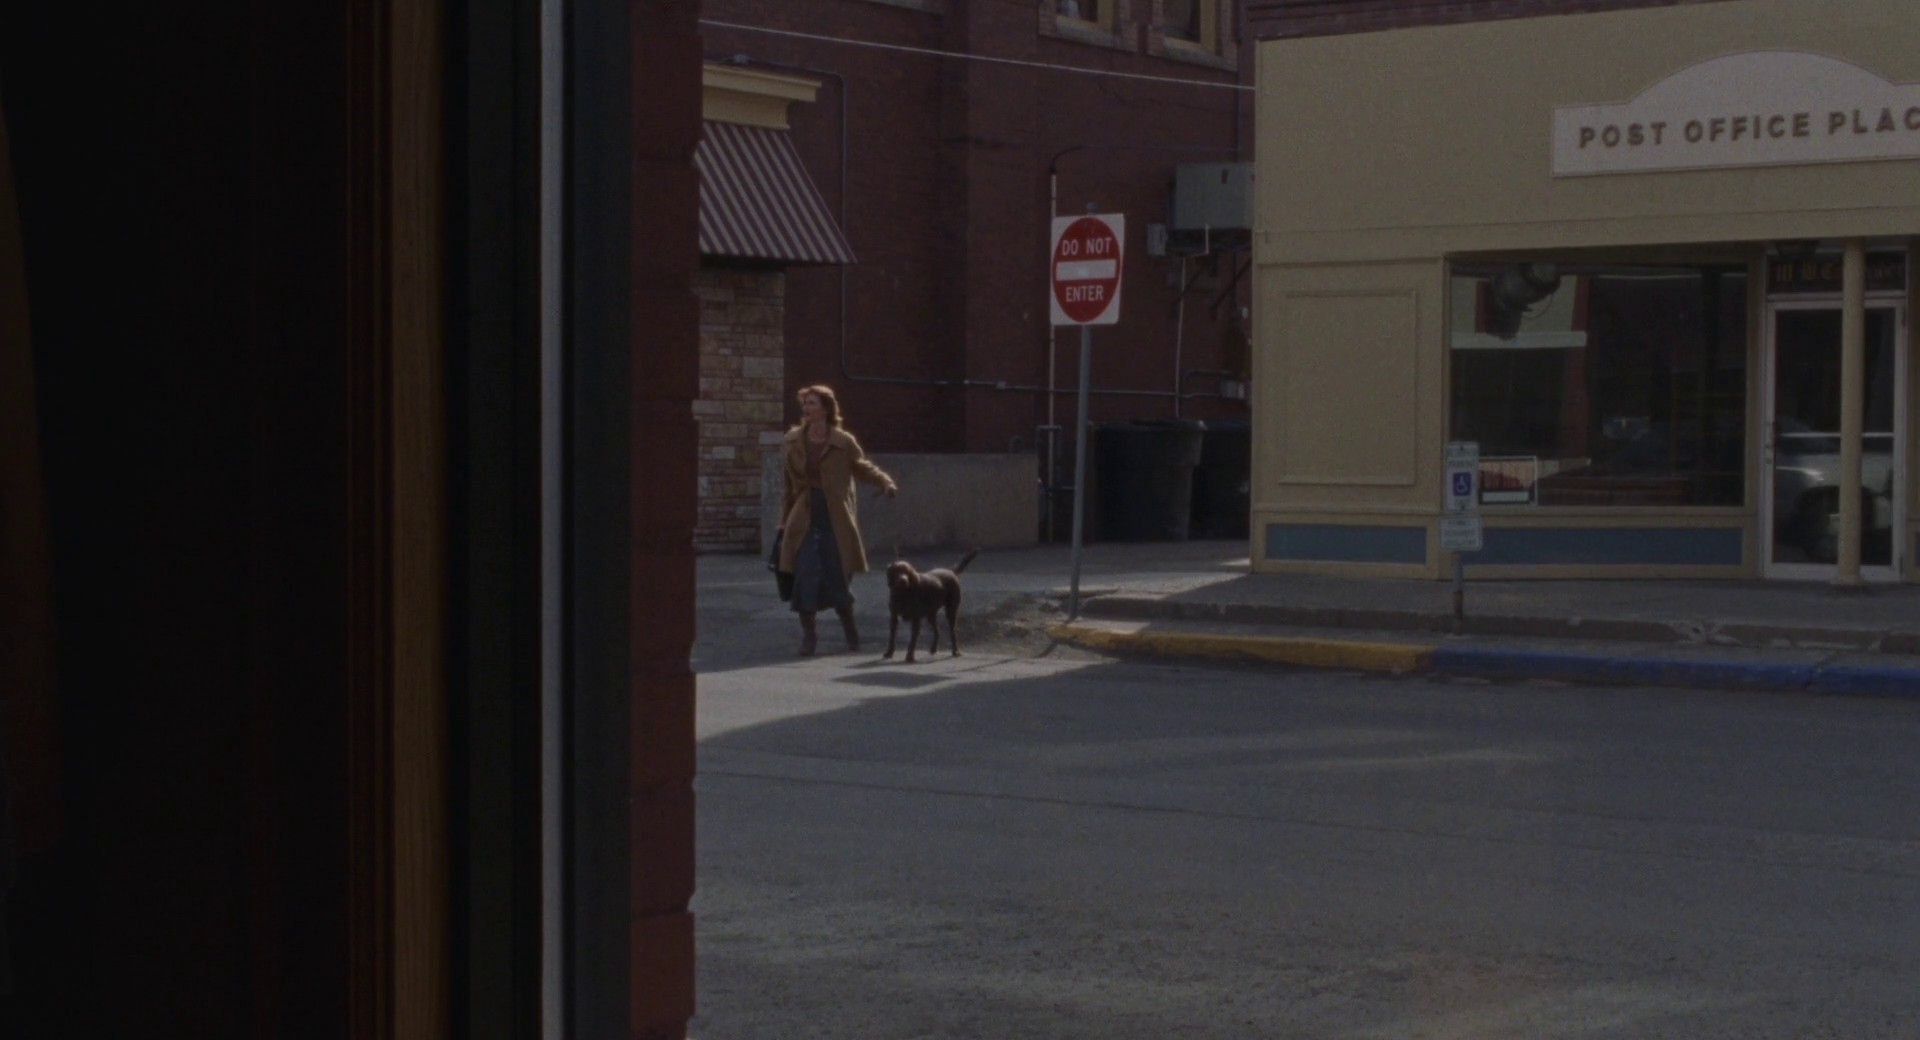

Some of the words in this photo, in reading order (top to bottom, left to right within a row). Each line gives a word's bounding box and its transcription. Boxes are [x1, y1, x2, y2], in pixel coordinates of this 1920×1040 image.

[1580, 121, 1667, 148] POST
[1684, 112, 1811, 144] OFFICE
[1062, 239, 1079, 256] DO
[1086, 237, 1112, 255] NOT
[1065, 285, 1104, 303] ENTER
